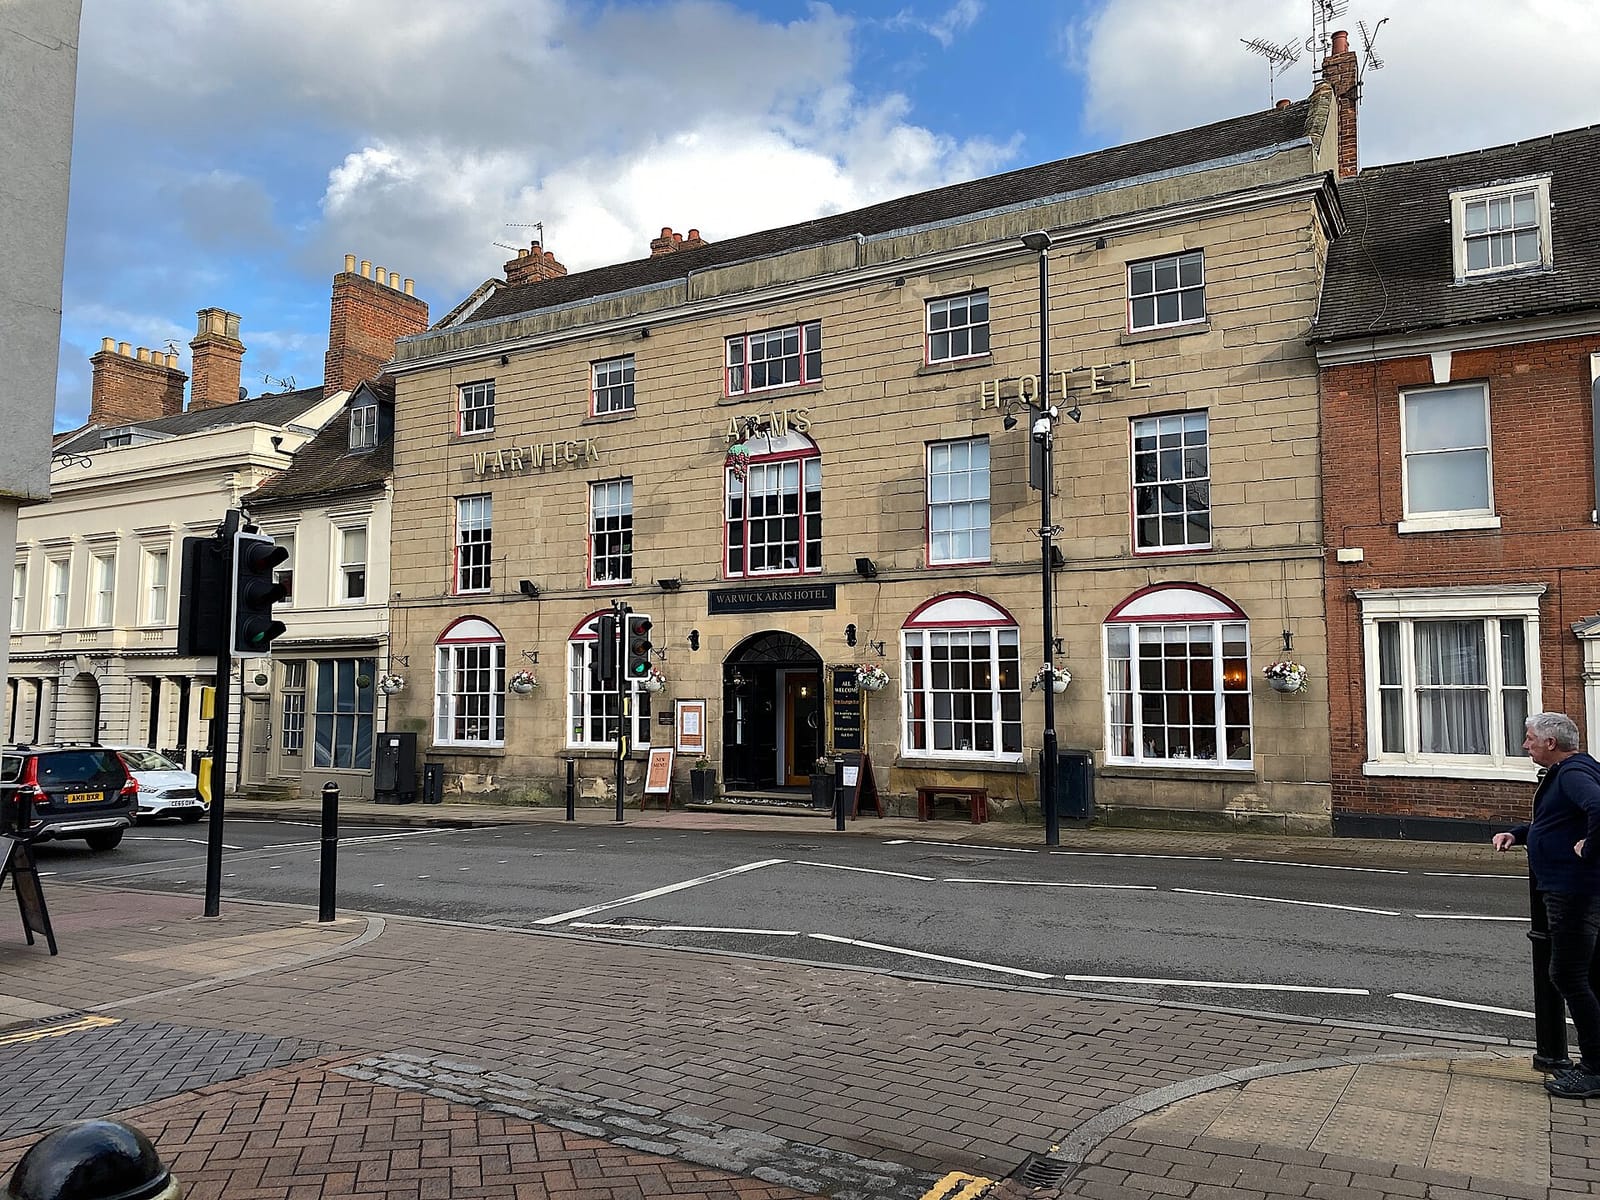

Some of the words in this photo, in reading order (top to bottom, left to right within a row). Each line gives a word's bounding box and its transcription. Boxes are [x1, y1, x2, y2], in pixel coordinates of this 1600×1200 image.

[980, 359, 1152, 411] HOTEL
[725, 407, 813, 444] ARMS
[472, 438, 600, 476] WARWICK
[716, 593, 764, 604] WARWICK
[764, 591, 792, 602] ARMS
[794, 589, 828, 600] HOTEL
